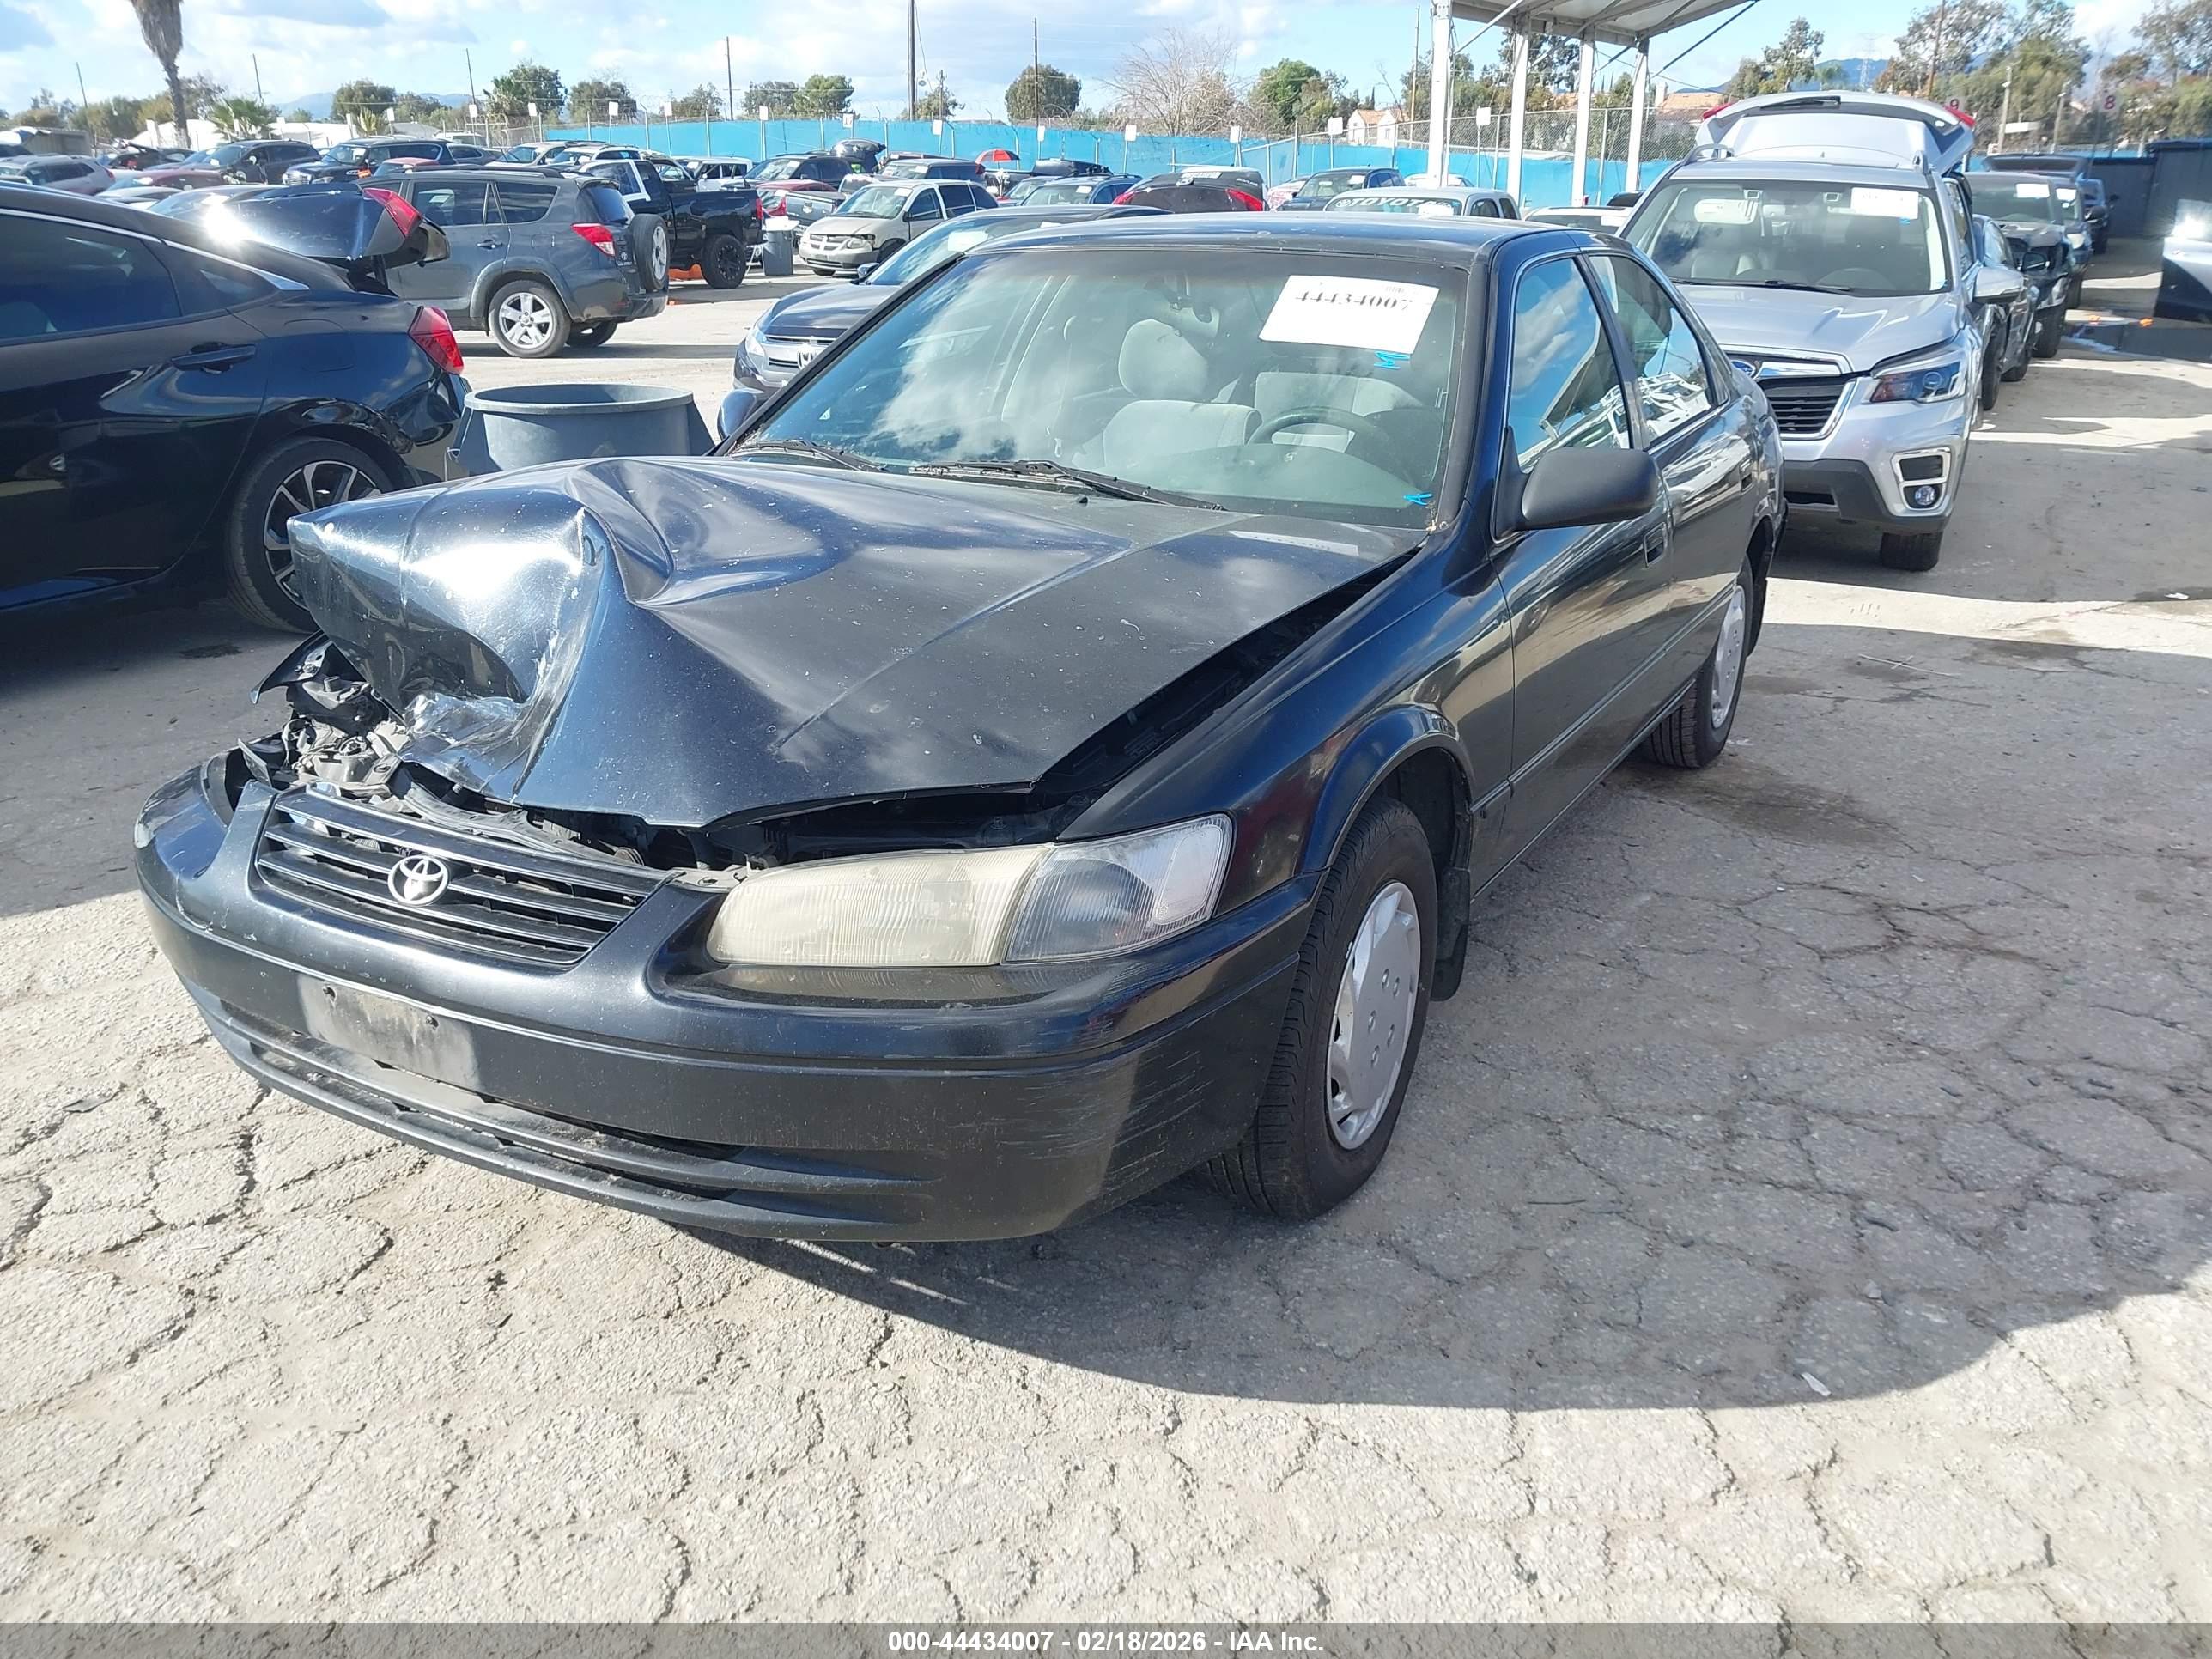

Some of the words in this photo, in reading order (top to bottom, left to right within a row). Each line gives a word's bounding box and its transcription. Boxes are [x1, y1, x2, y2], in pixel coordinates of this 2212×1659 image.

[1949, 98, 1959, 110] 9
[2104, 94, 2116, 110] 8
[1295, 291, 1413, 311] 44434007
